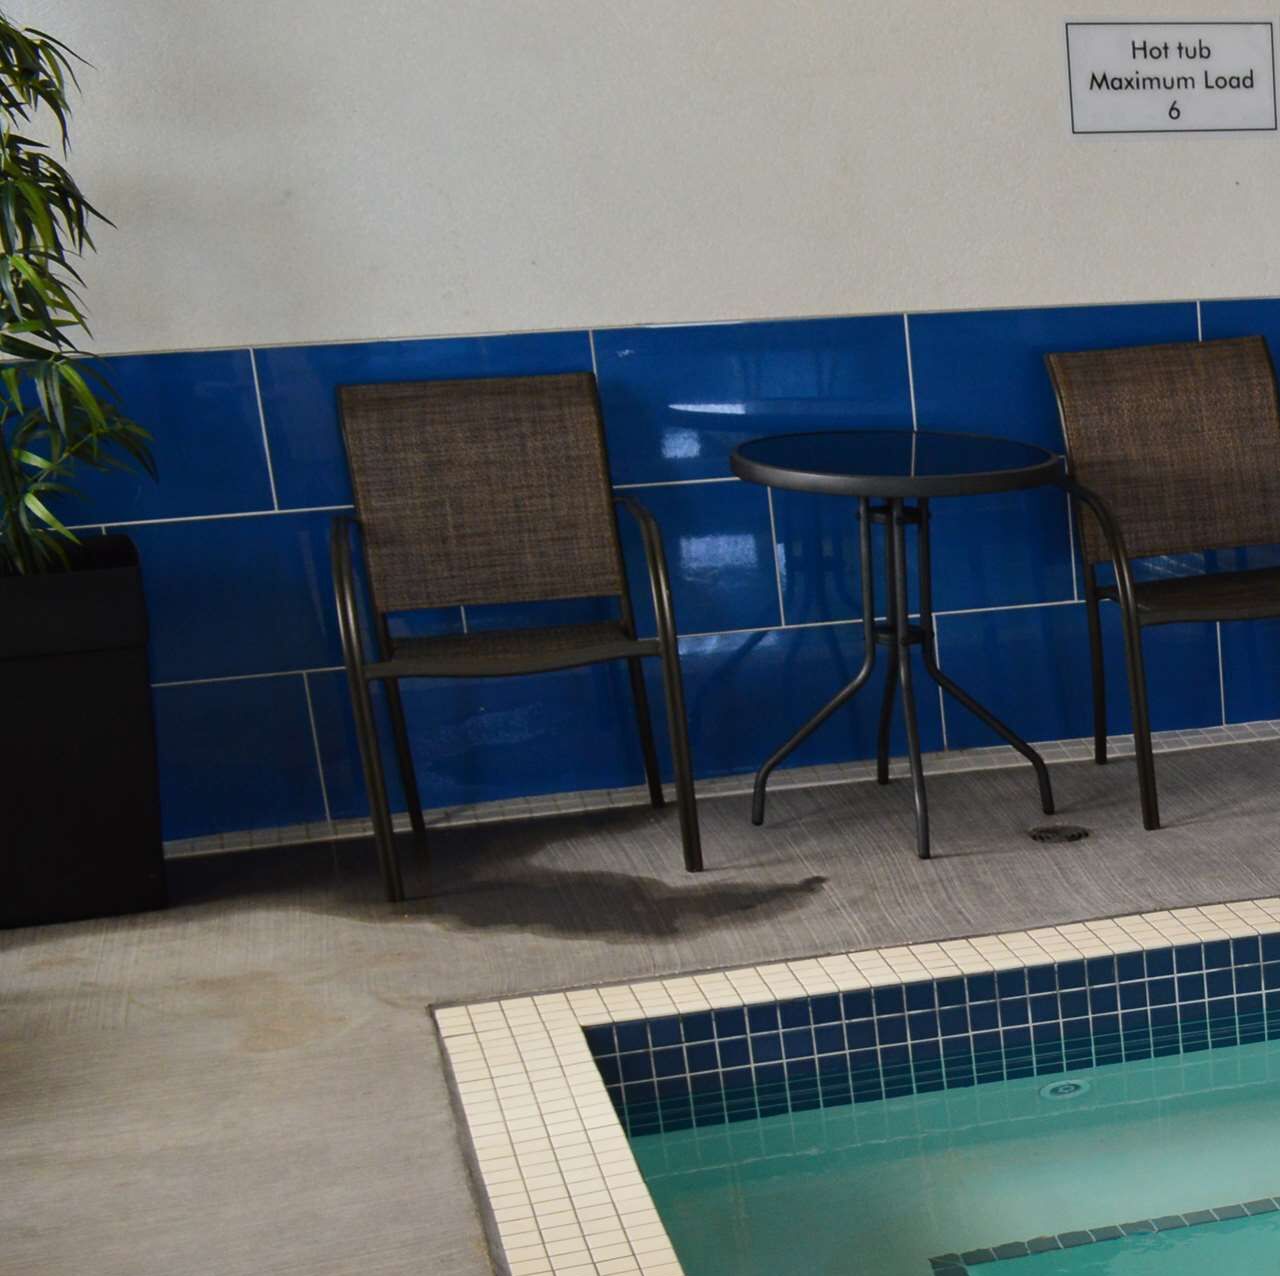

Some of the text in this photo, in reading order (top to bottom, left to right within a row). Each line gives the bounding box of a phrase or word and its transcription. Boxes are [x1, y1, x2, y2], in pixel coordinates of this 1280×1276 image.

[1131, 39, 1211, 59] Hot tub
[1089, 69, 1254, 90] Maximum Load
[1168, 100, 1181, 120] 6
